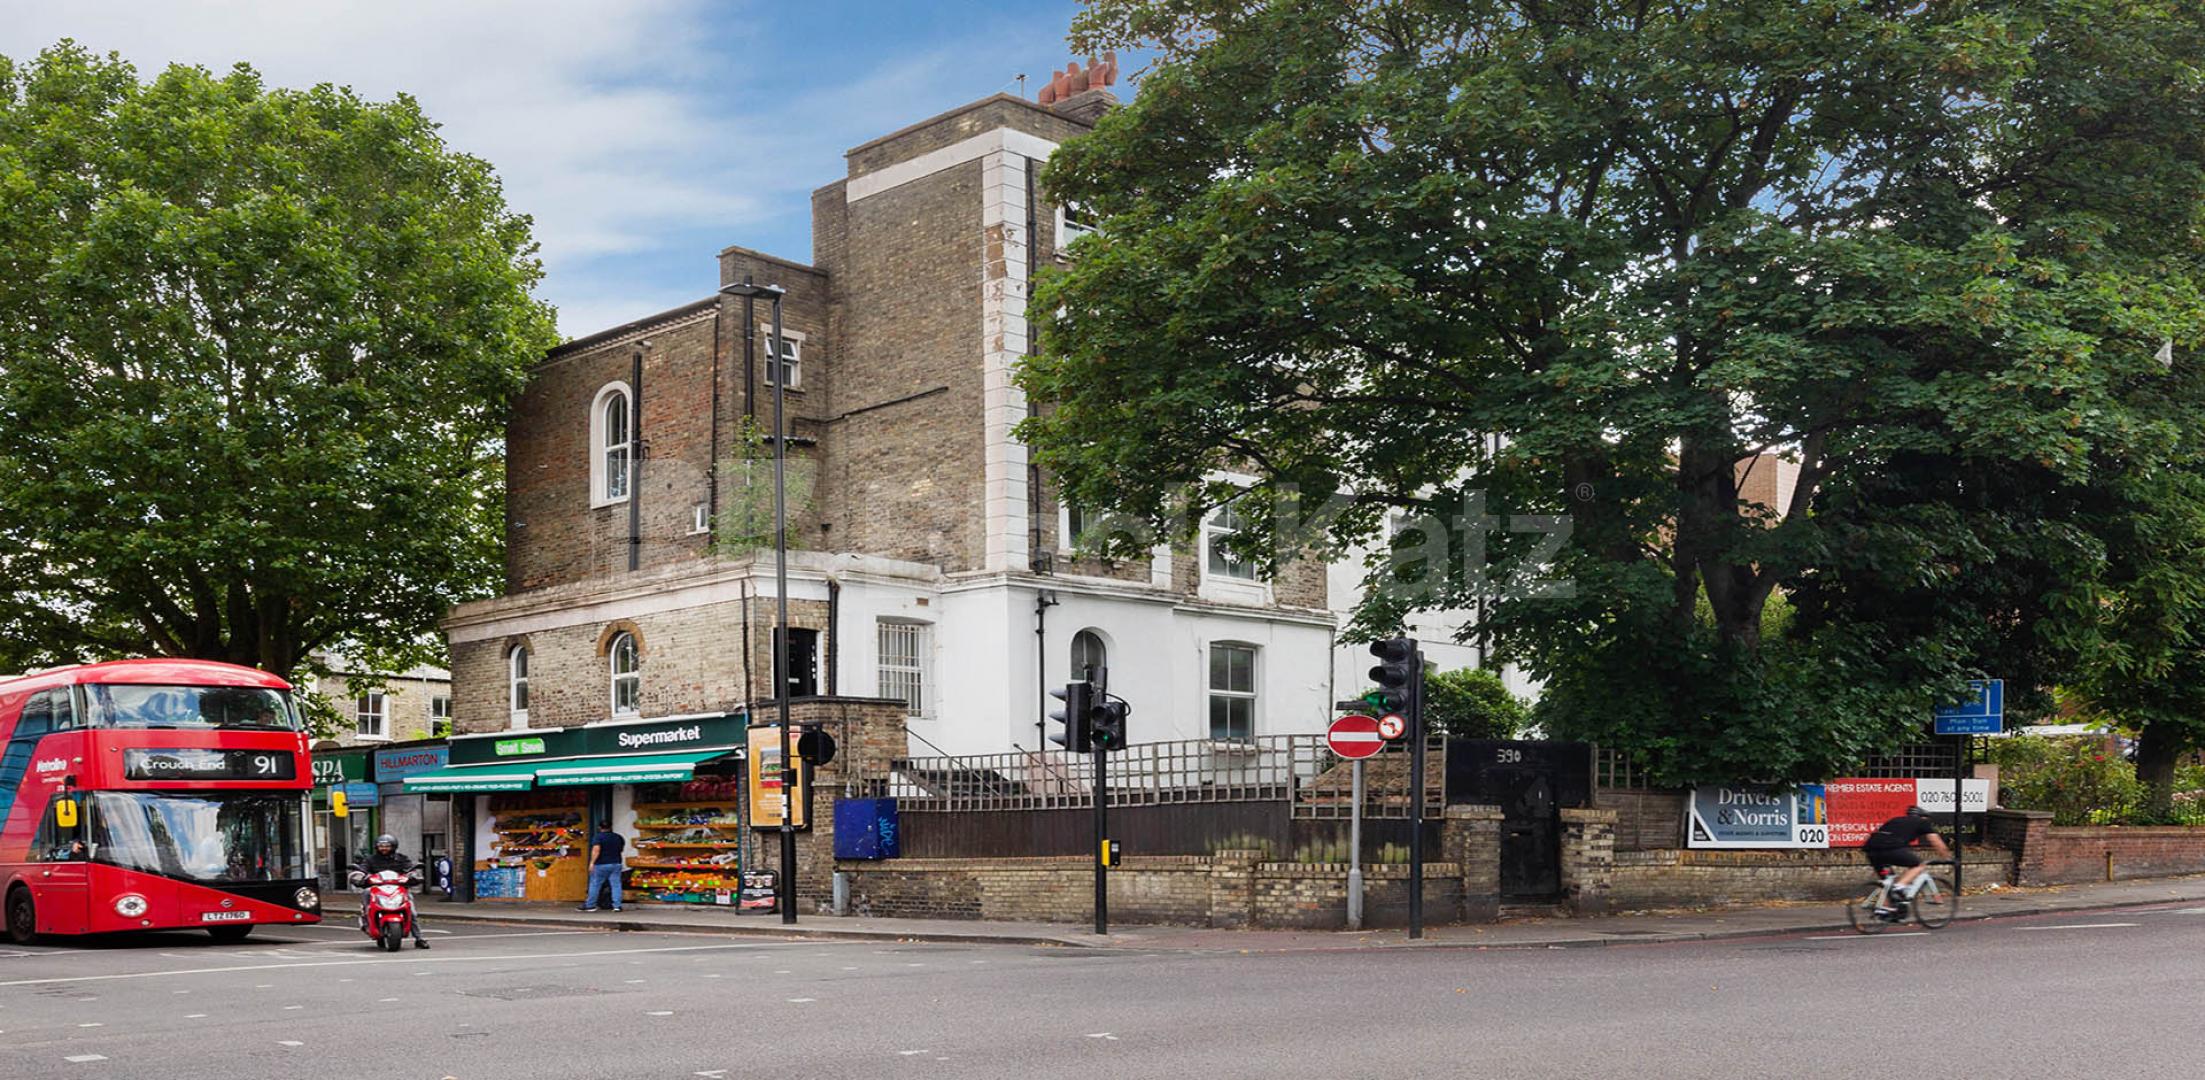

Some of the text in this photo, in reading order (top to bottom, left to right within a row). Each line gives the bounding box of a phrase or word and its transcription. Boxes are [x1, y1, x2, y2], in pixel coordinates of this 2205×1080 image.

[618, 725, 701, 748] Supermarket
[380, 753, 438, 769] HILLMARTON
[1497, 749, 1520, 763] 390
[140, 758, 193, 770] Crouch
[254, 755, 276, 774] 91
[1856, 784, 1883, 793] ESTATE
[1884, 784, 1914, 793] AGENTS
[1718, 788, 1781, 806] Drivers
[1920, 791, 1939, 803] 020
[1963, 791, 1984, 803] 5001
[1799, 829, 1825, 843] 020
